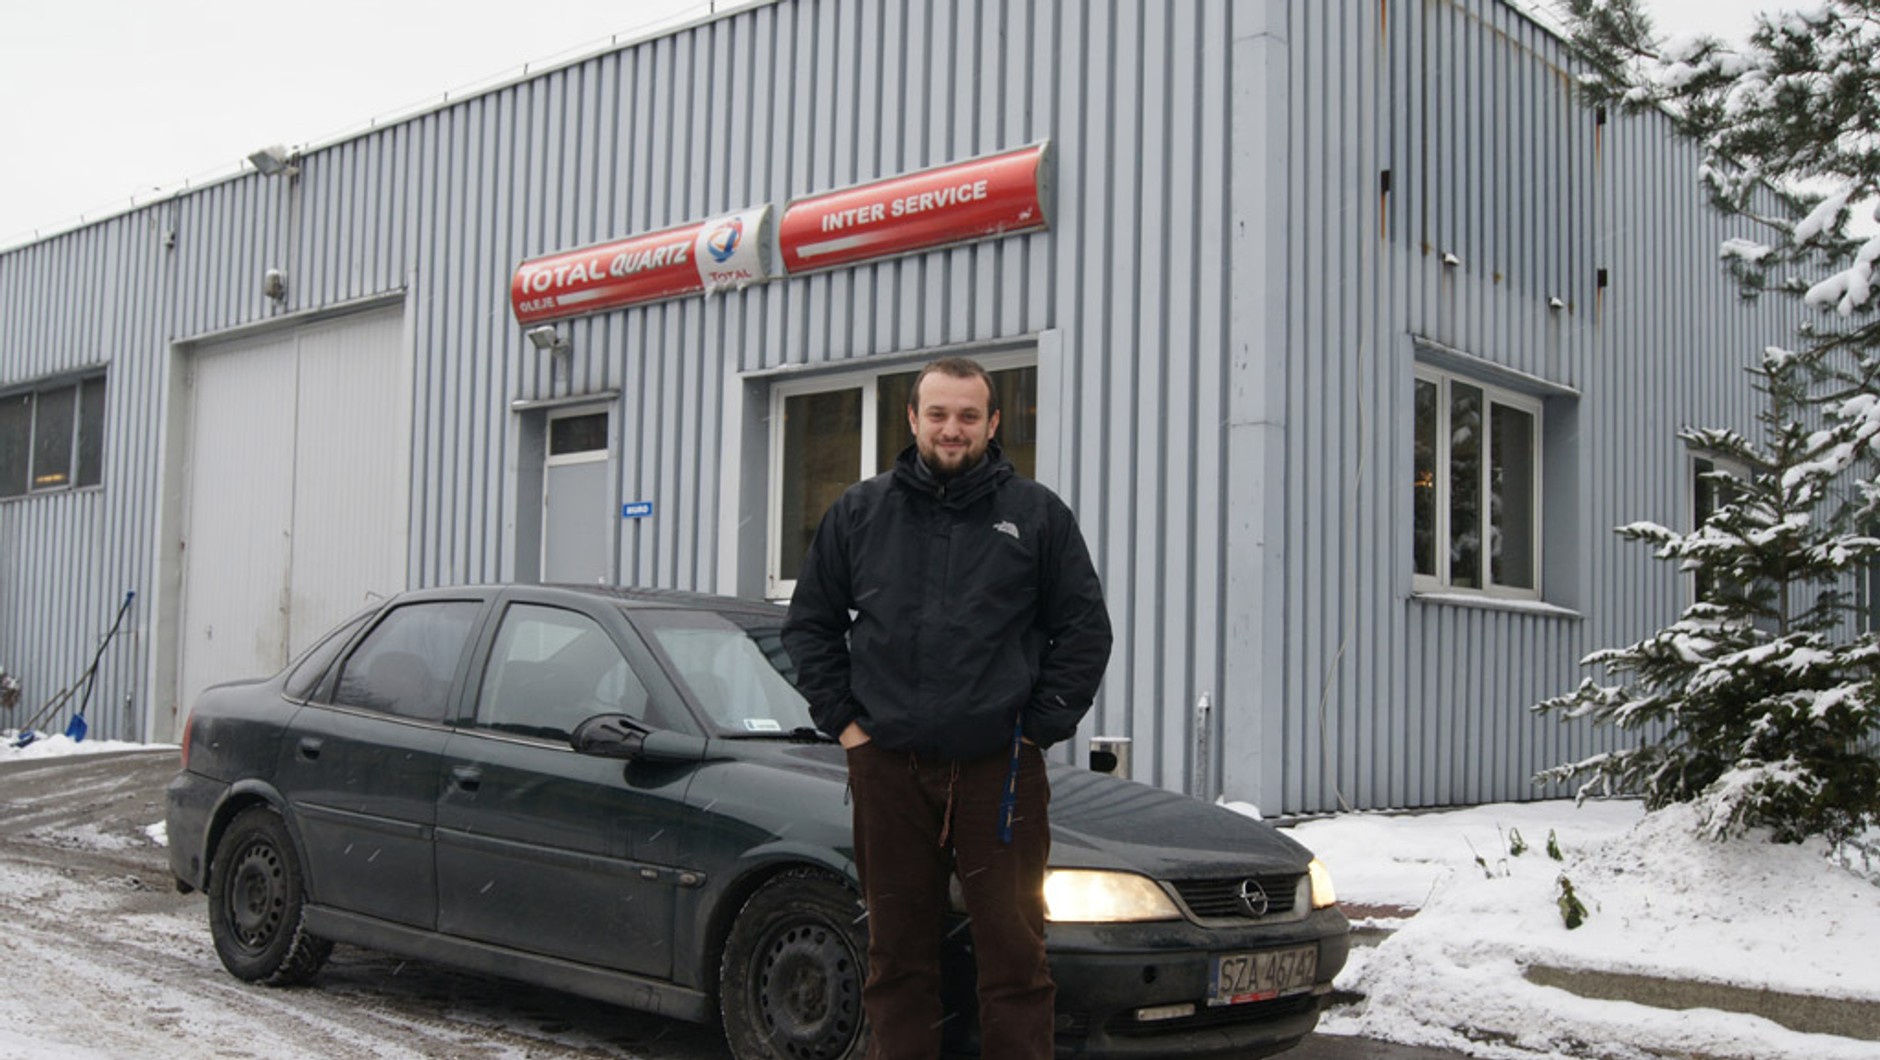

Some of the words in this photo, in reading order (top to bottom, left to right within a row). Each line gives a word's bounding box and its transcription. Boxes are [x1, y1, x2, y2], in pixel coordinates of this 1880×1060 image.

[821, 204, 885, 233] INTER
[891, 179, 988, 218] SERVICE
[519, 257, 606, 295] TOTAL
[609, 240, 694, 278] QUARTZ
[519, 296, 556, 313] OLEJE
[1221, 956, 1259, 993] SZA
